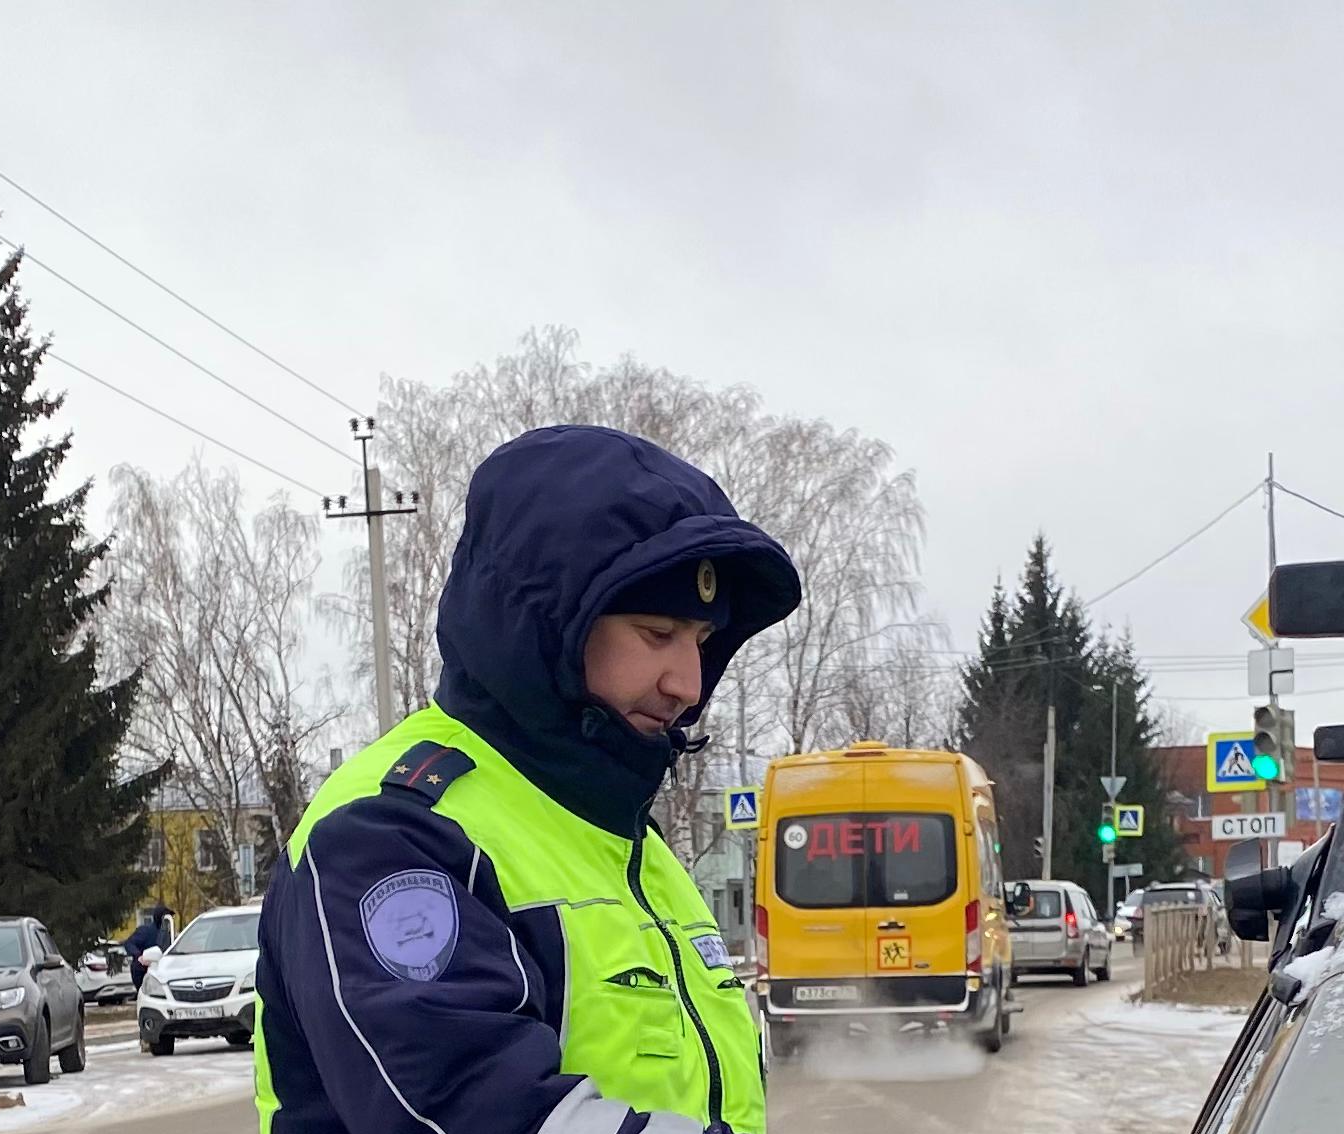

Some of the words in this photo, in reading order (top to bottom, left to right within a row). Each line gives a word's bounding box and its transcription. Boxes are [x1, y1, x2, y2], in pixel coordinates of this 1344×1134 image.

[788, 831, 803, 842] 60
[806, 820, 920, 863] ДЕТИ
[1222, 817, 1276, 835] СТОП
[365, 875, 445, 913] ПОЛИЦИЯ
